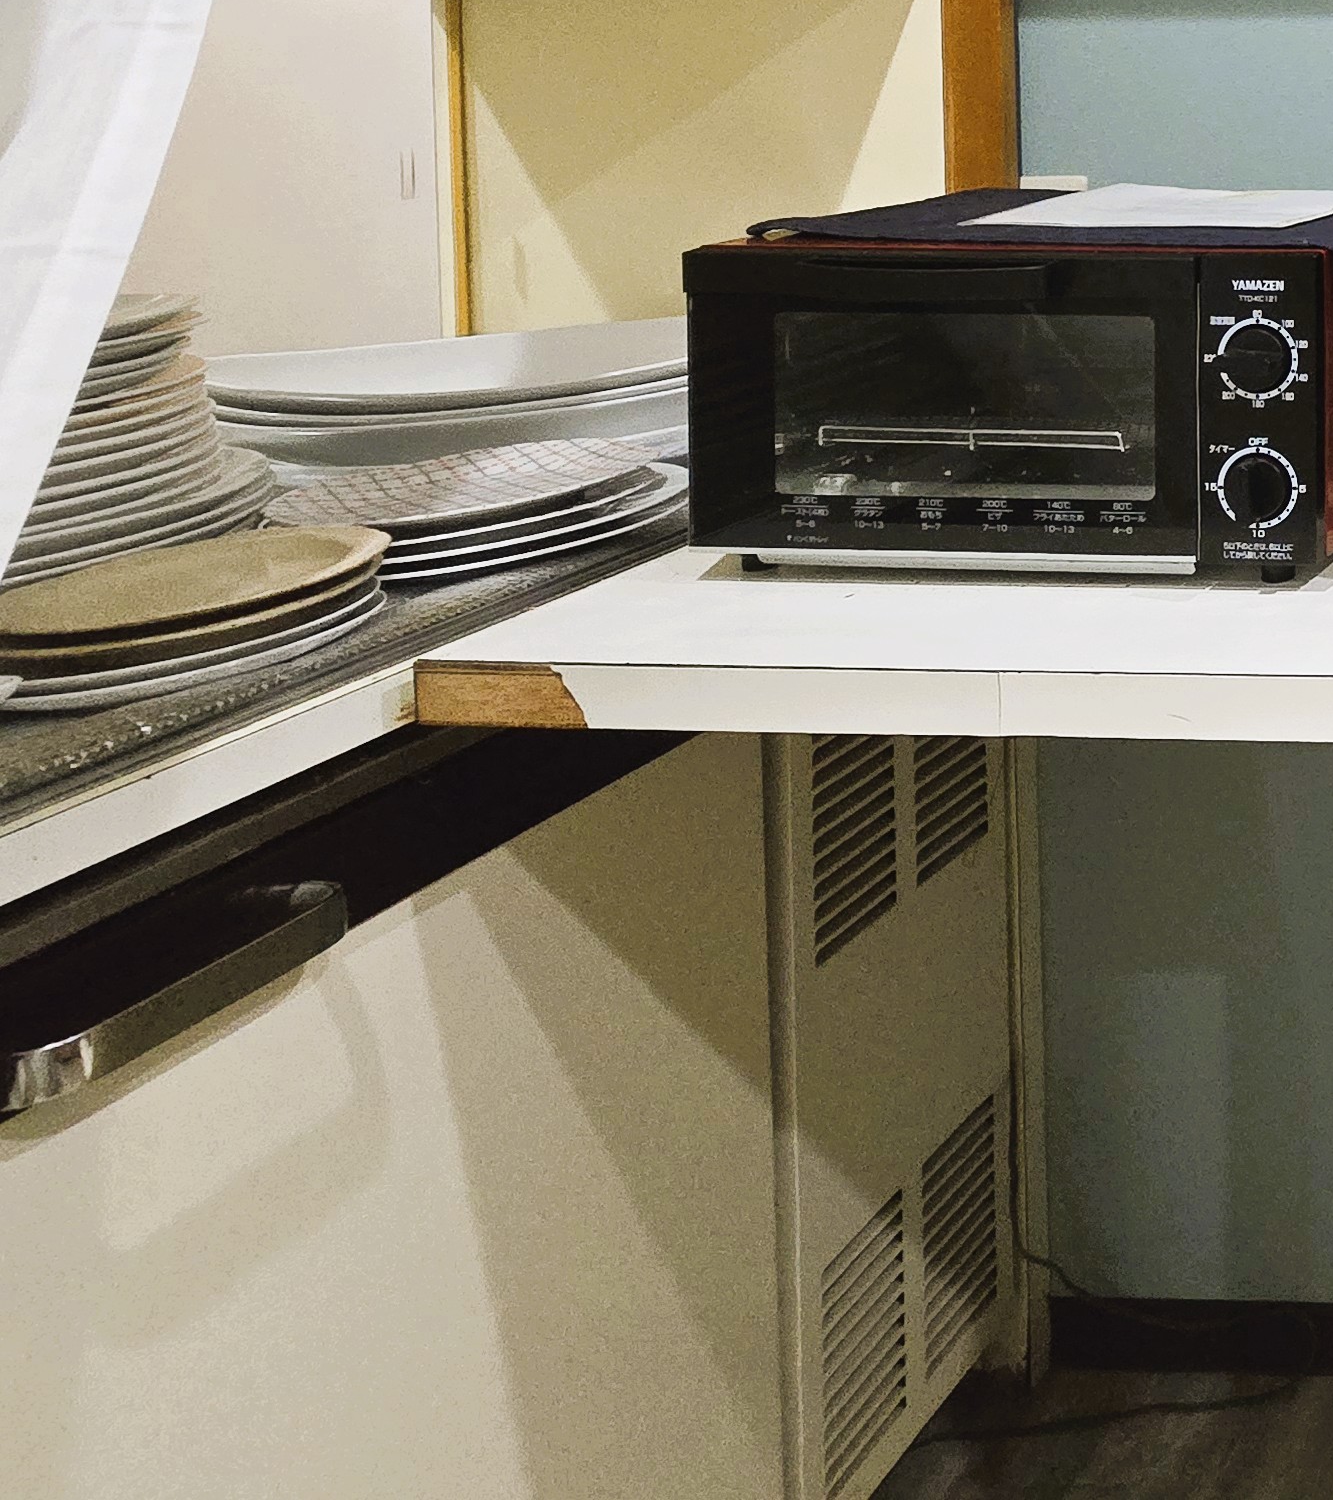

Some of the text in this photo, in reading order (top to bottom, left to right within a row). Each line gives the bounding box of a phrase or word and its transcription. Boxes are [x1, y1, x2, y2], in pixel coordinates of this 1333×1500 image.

[1232, 279, 1285, 292] YAMAZEN
[1248, 437, 1269, 446] OFF
[1209, 444, 1236, 453] タイマー
[1204, 482, 1218, 492] 15
[1298, 484, 1307, 494] 5
[853, 509, 883, 518] グラタン
[920, 511, 943, 520] おもち
[987, 512, 1003, 520] ピザ
[1252, 529, 1266, 538] 10
